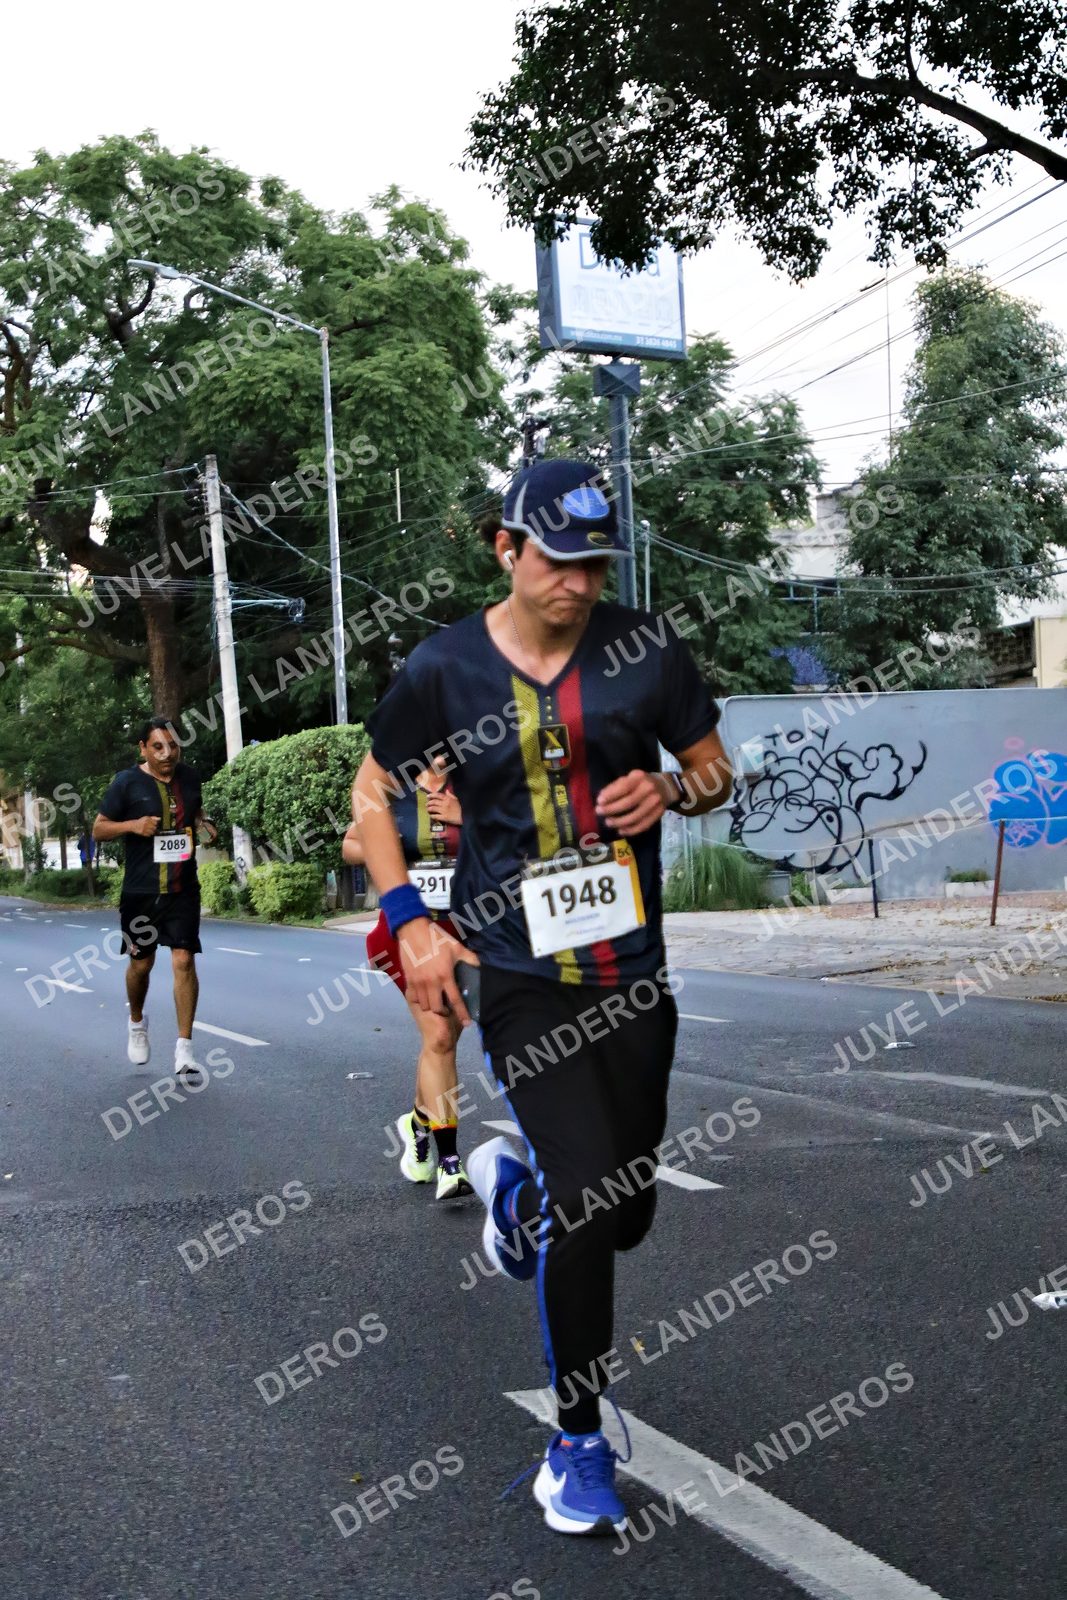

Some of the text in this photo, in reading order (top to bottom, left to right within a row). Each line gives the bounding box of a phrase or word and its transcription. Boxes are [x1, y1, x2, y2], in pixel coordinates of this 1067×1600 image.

[764, 726, 830, 750] TOY
[160, 839, 186, 850] 2089
[417, 875, 452, 893] 291
[541, 875, 616, 917] 1948
